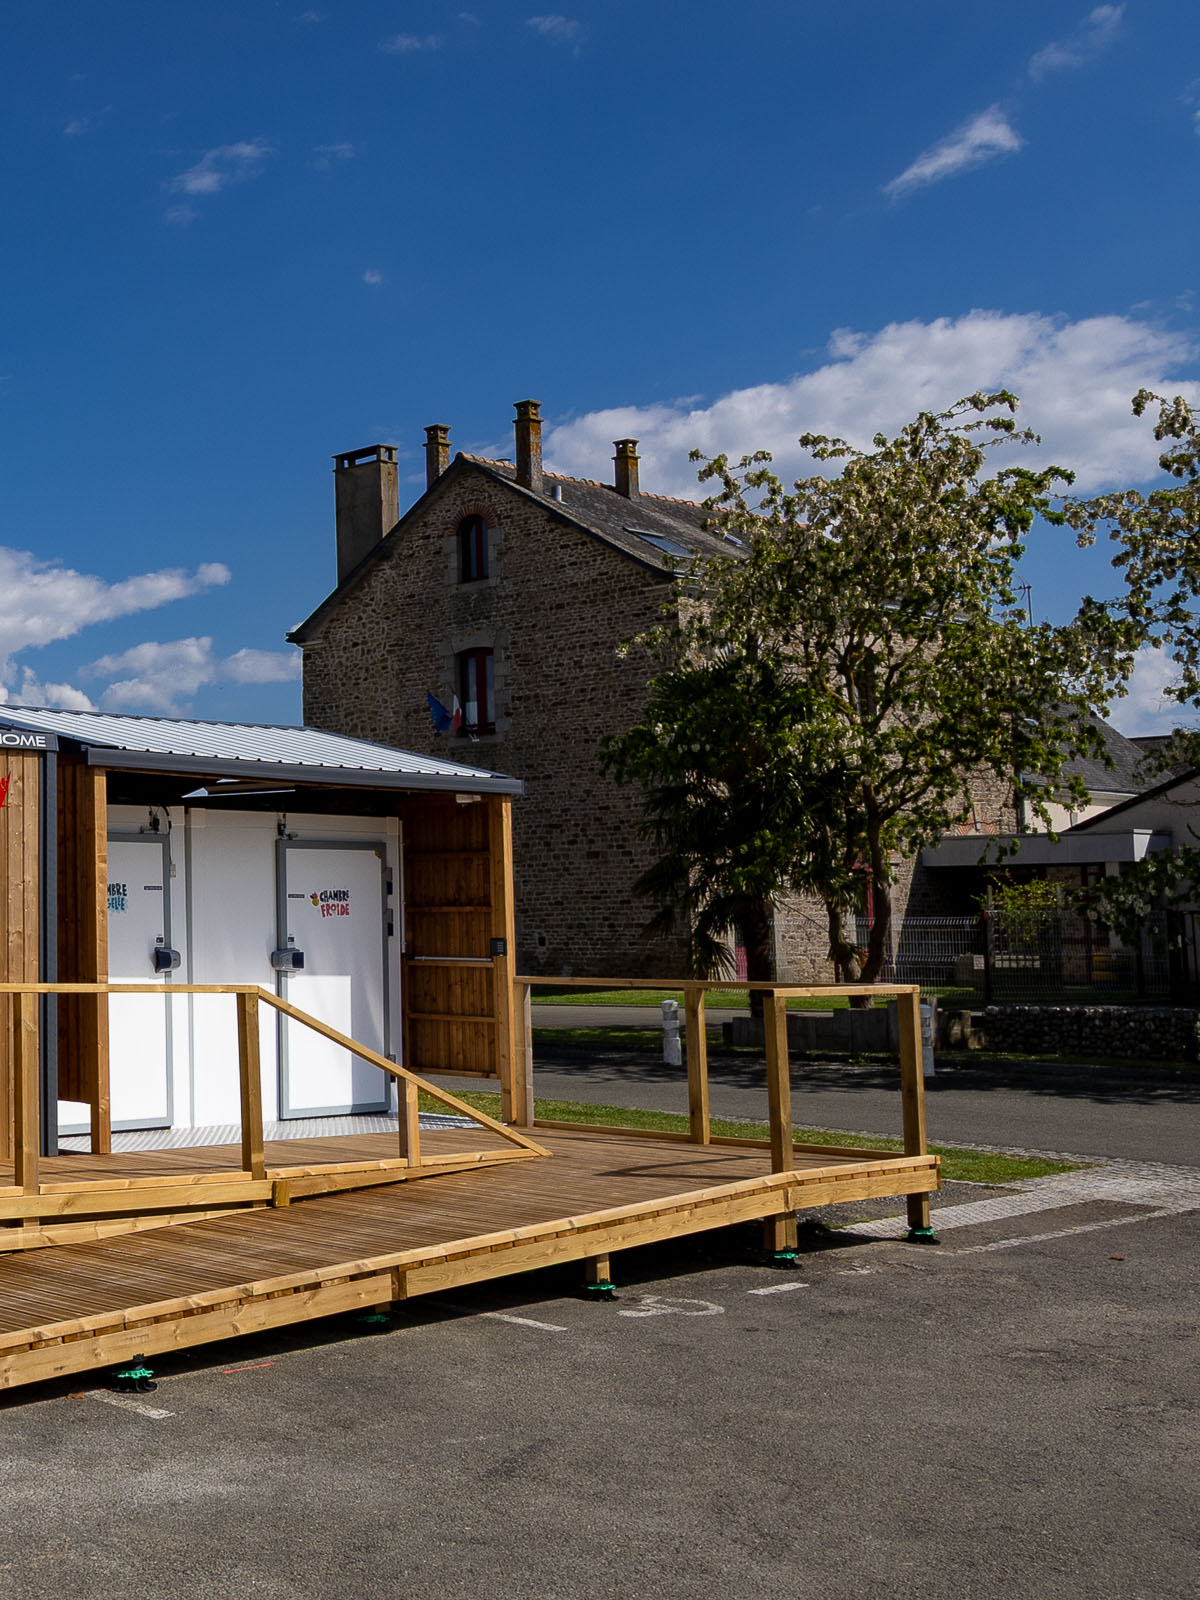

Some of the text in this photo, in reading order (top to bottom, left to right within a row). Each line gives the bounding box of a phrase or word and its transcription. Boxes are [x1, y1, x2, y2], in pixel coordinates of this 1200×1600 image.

[107, 883, 127, 897] MBRE
[319, 889, 350, 903] CHAMBRE
[320, 903, 350, 918] FROIDE
